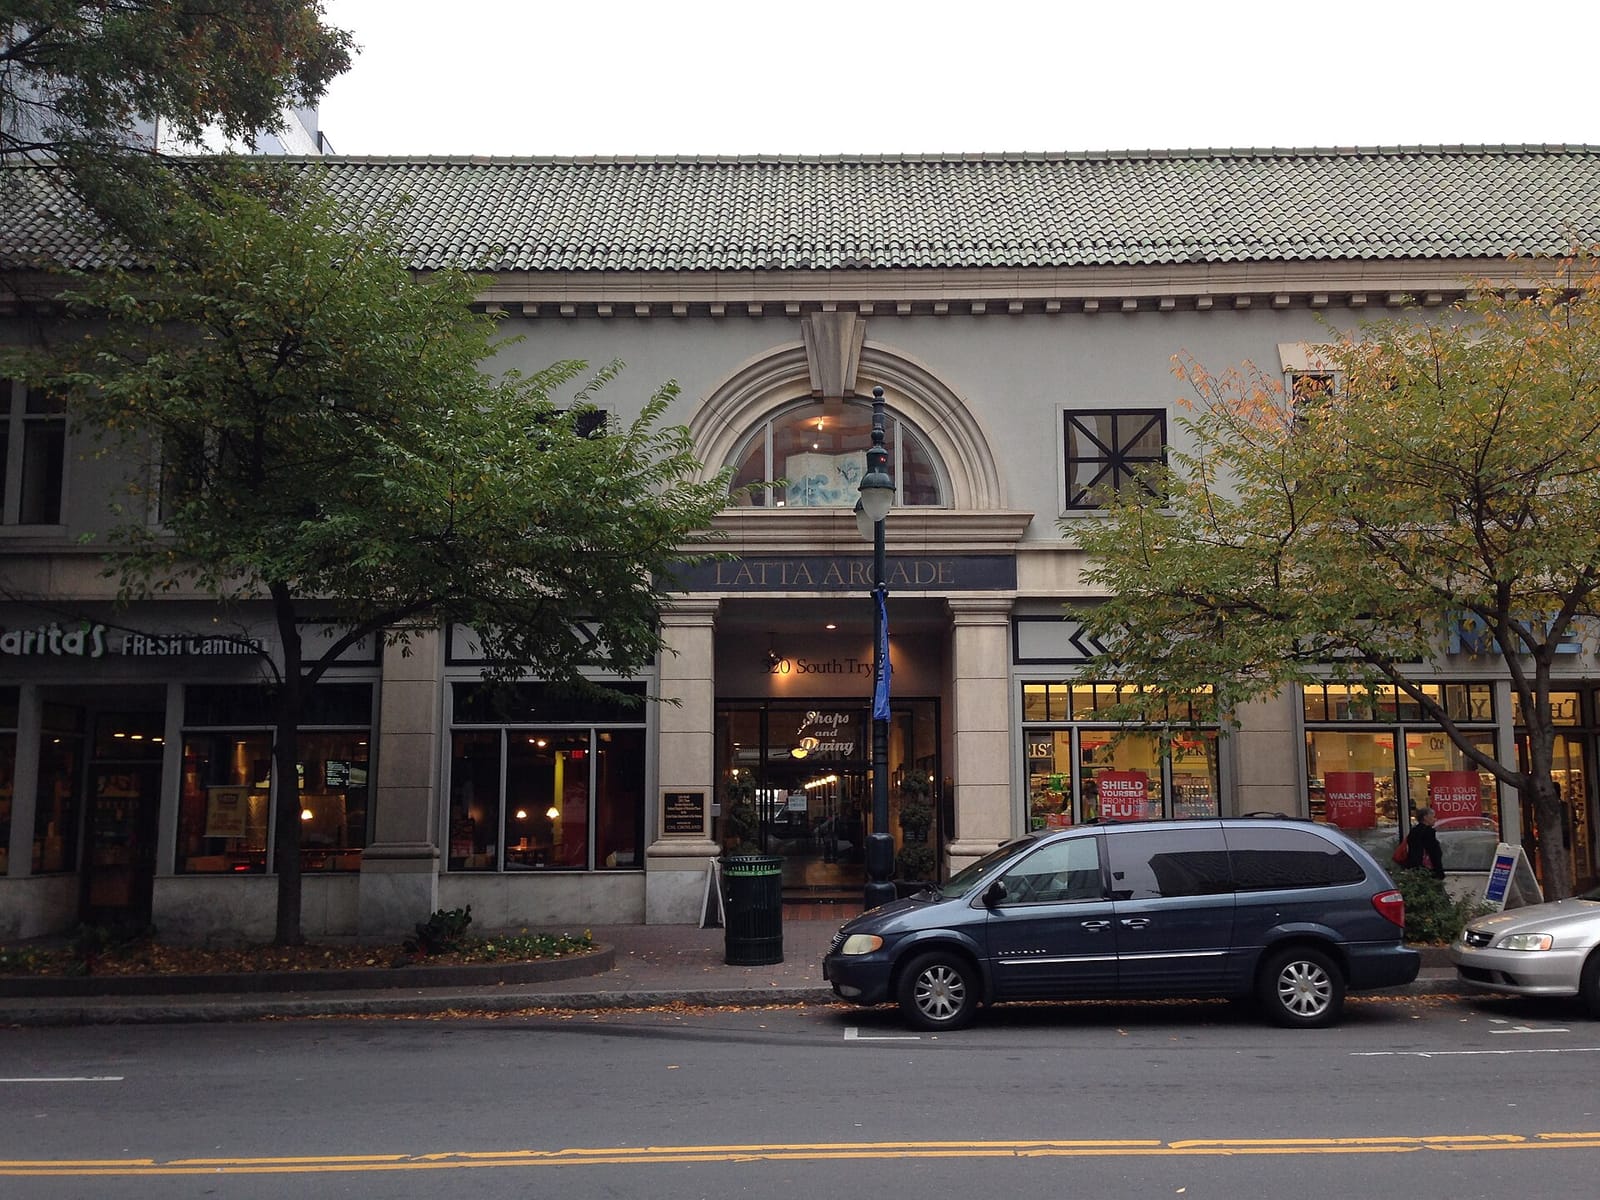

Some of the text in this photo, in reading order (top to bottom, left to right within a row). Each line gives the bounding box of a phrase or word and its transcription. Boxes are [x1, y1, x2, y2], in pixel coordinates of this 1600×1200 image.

[714, 561, 816, 585] LATTA
[796, 658, 842, 674] South
[847, 658, 895, 678] Try
[804, 711, 850, 728] Shops
[815, 729, 838, 737] and
[800, 737, 855, 755] Dining
[1101, 780, 1144, 790] SHIELD
[1433, 786, 1477, 794] GET YOUR
[1329, 792, 1372, 800] WALK-INS
[1329, 800, 1373, 808] WELCOME
[1435, 801, 1478, 812] TODAY
[1101, 804, 1133, 816] FLU
